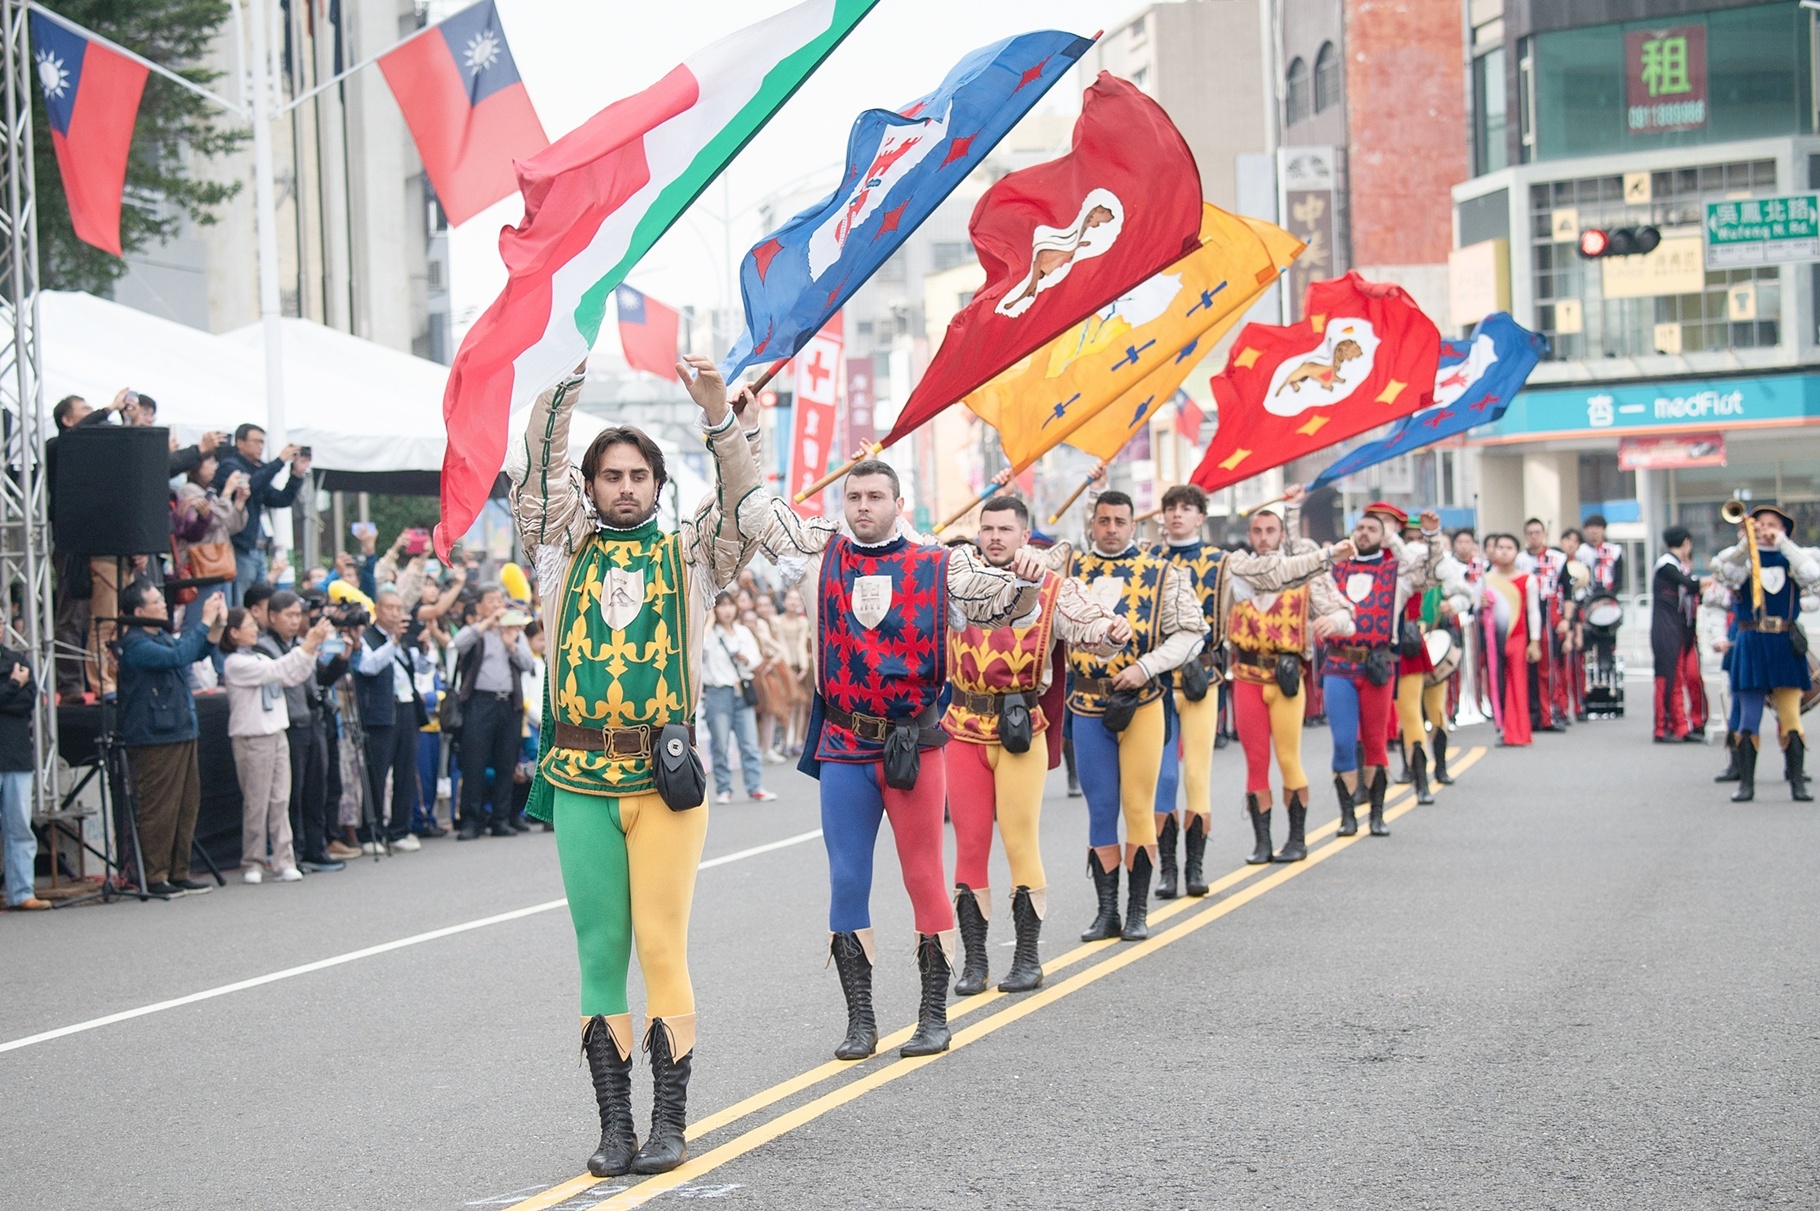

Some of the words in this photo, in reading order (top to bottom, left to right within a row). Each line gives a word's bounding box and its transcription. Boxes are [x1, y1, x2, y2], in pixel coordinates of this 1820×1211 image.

[1640, 36, 1692, 97] 租
[1717, 198, 1809, 226] 吳鳳北路
[1717, 224, 1771, 240] Wufeng
[1789, 220, 1812, 235] Rd.
[1587, 394, 1645, 428] 杏一
[1654, 390, 1744, 419] medFirst
